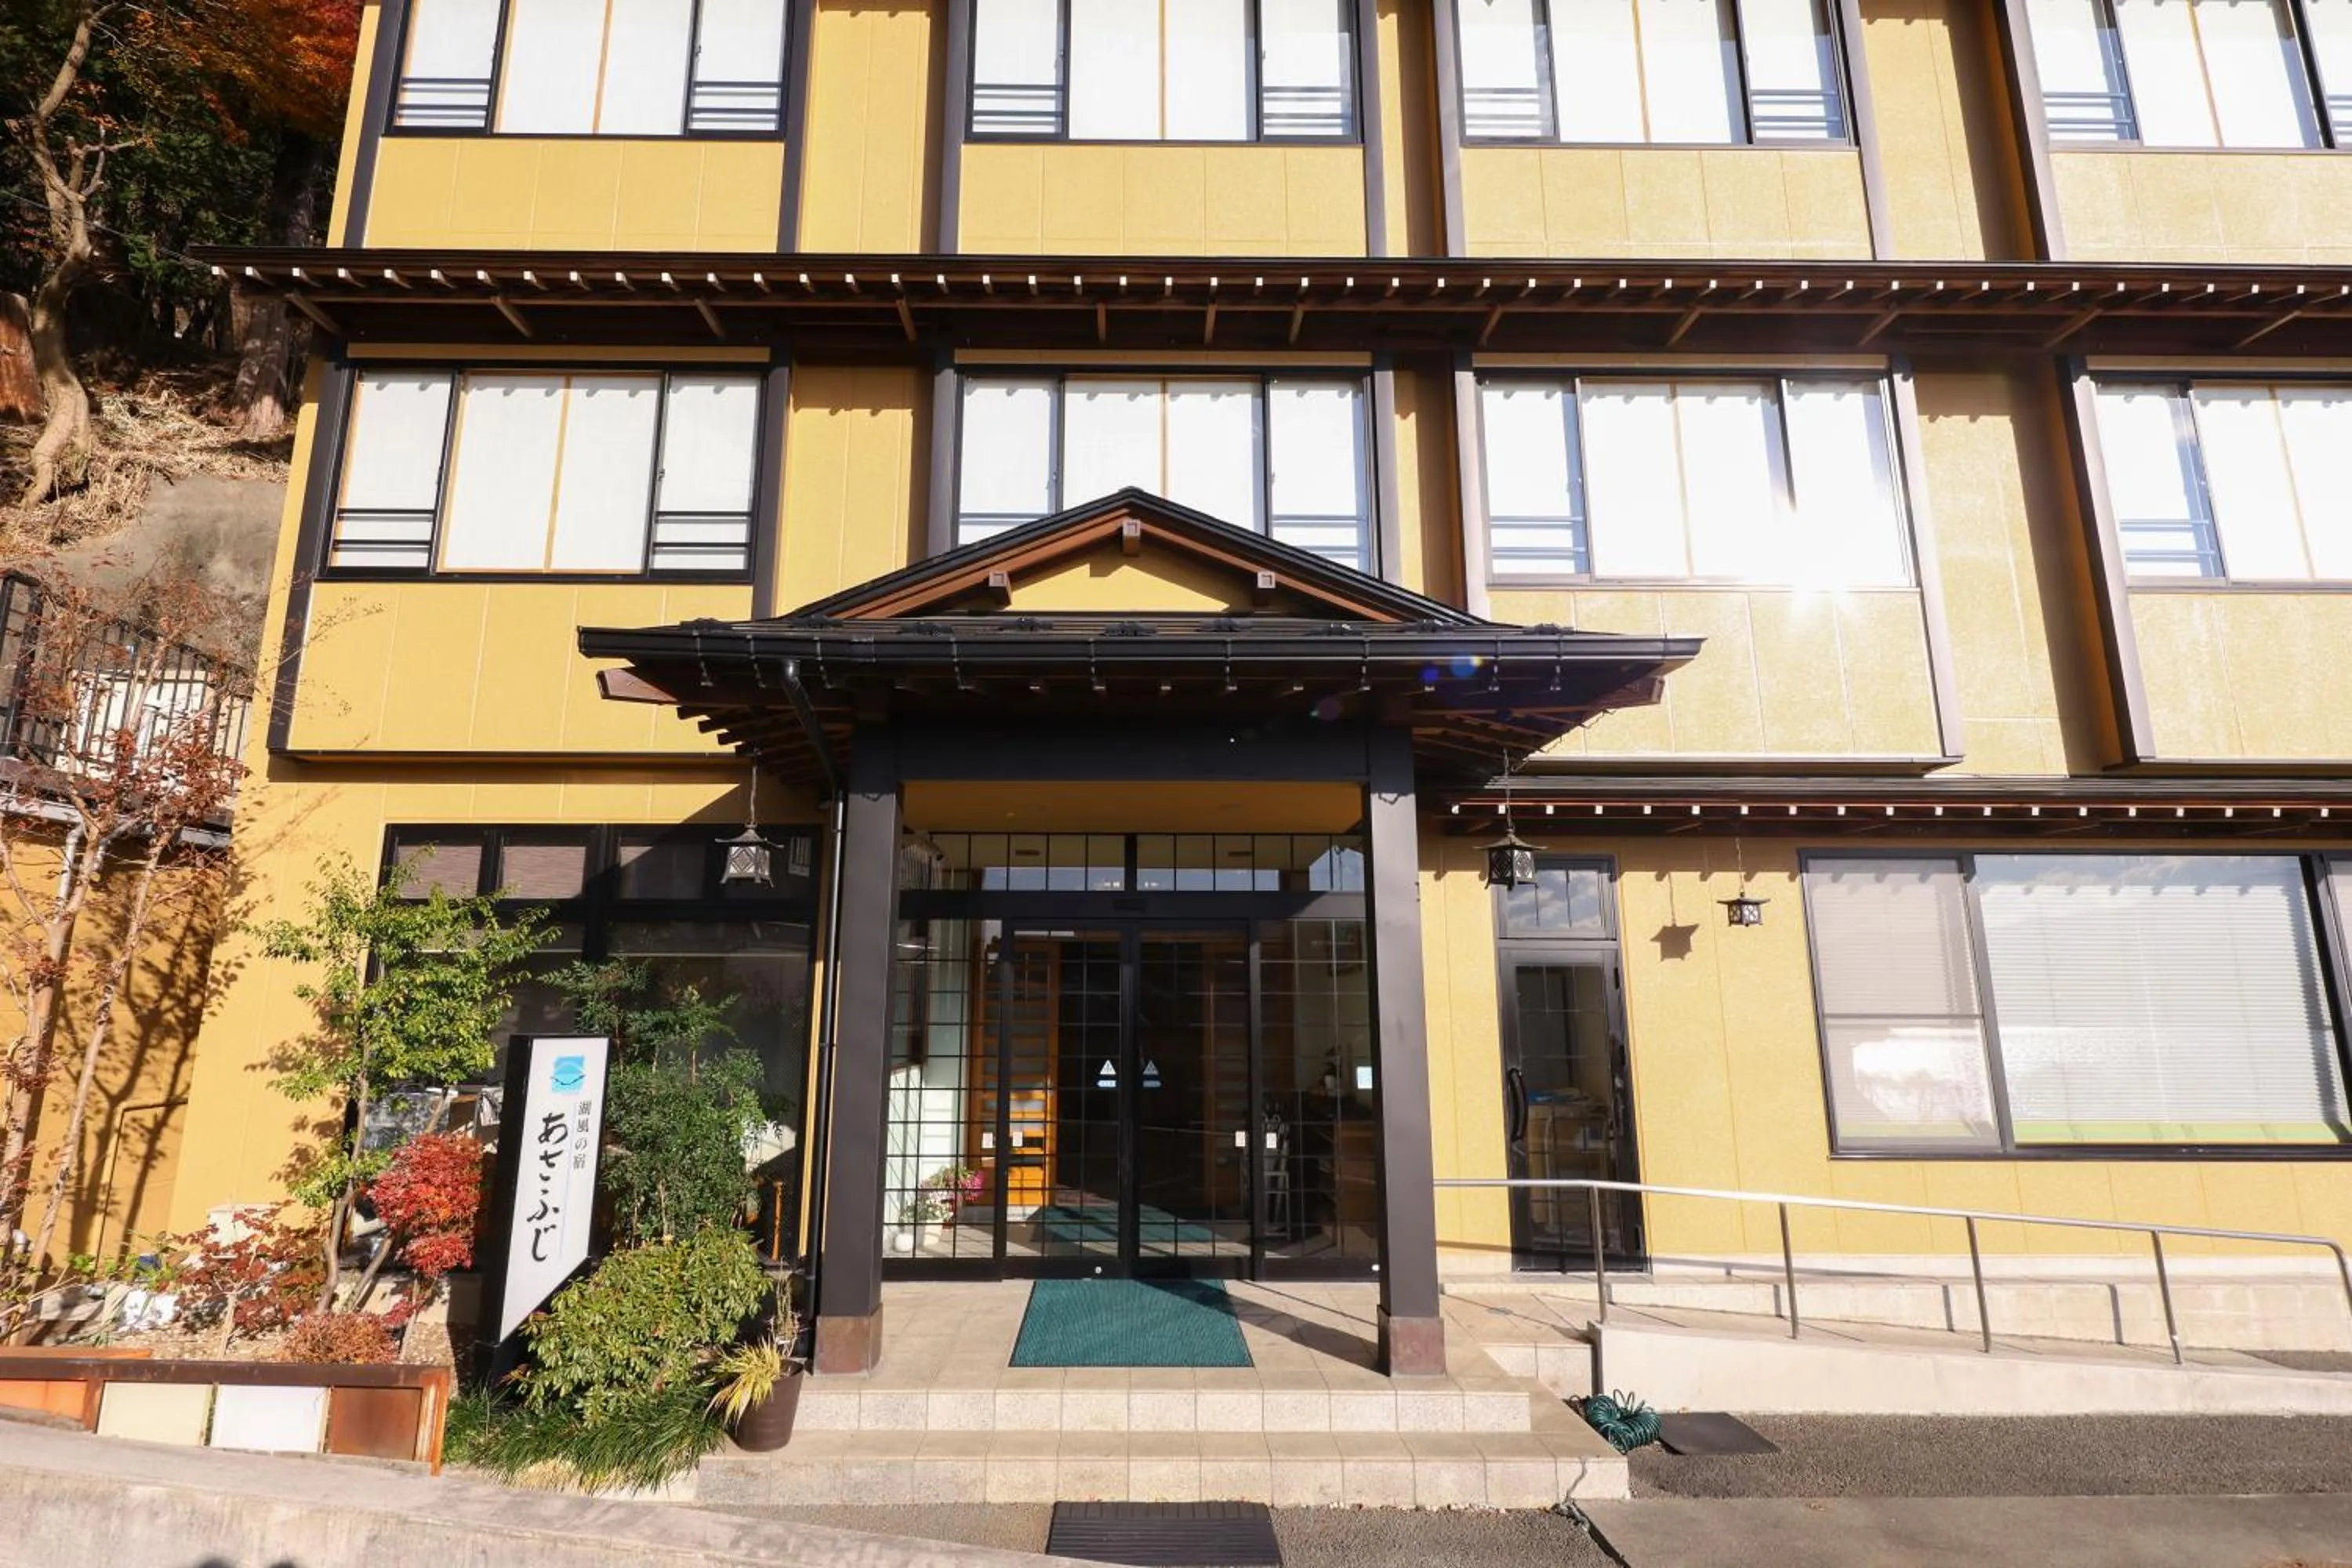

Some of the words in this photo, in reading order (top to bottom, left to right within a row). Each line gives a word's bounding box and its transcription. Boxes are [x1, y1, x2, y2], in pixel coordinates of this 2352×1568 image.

[527, 1112, 569, 1262] あさふじ
[572, 1100, 592, 1169] 湖風の宿
